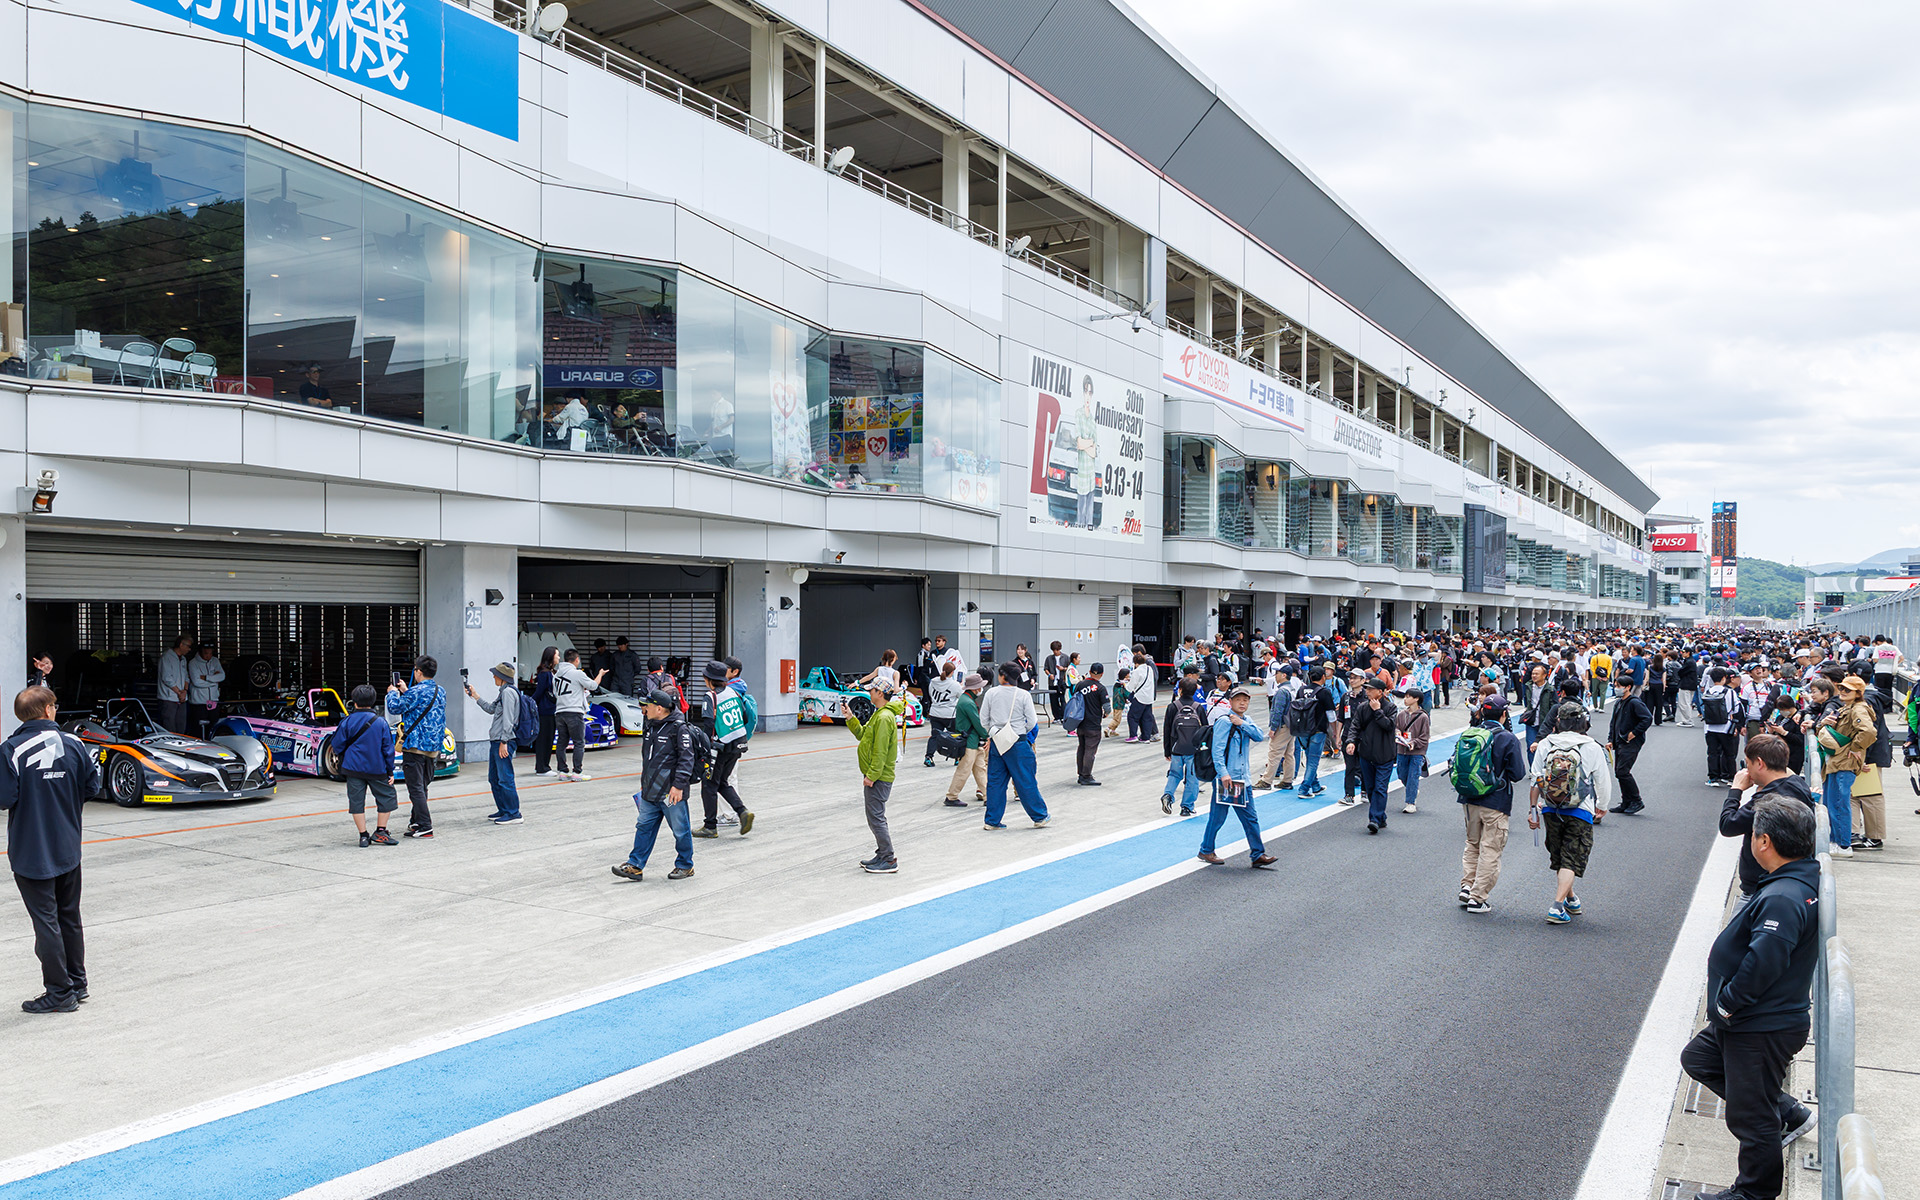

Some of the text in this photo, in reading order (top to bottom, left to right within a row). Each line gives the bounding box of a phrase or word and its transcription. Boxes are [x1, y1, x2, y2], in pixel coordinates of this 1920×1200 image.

[1198, 351, 1229, 380] TOYOTA
[1031, 355, 1072, 398] INITIAL
[1198, 371, 1230, 394] AUTO BODY
[1125, 388, 1144, 416] 30th
[1249, 379, 1294, 418] トヨタ車体
[1094, 401, 1144, 439] Anniversary
[869, 438, 885, 453] ty
[1119, 434, 1144, 462] 2days
[1334, 416, 1382, 460] BRIDGESTONE
[1652, 537, 1686, 547] ENSO
[467, 610, 481, 626] 25
[768, 612, 777, 626] 24
[1134, 634, 1157, 642] Team
[718, 699, 739, 713] MEDIA
[722, 706, 744, 727] 091
[828, 702, 836, 713] 4
[296, 742, 313, 760] 714
